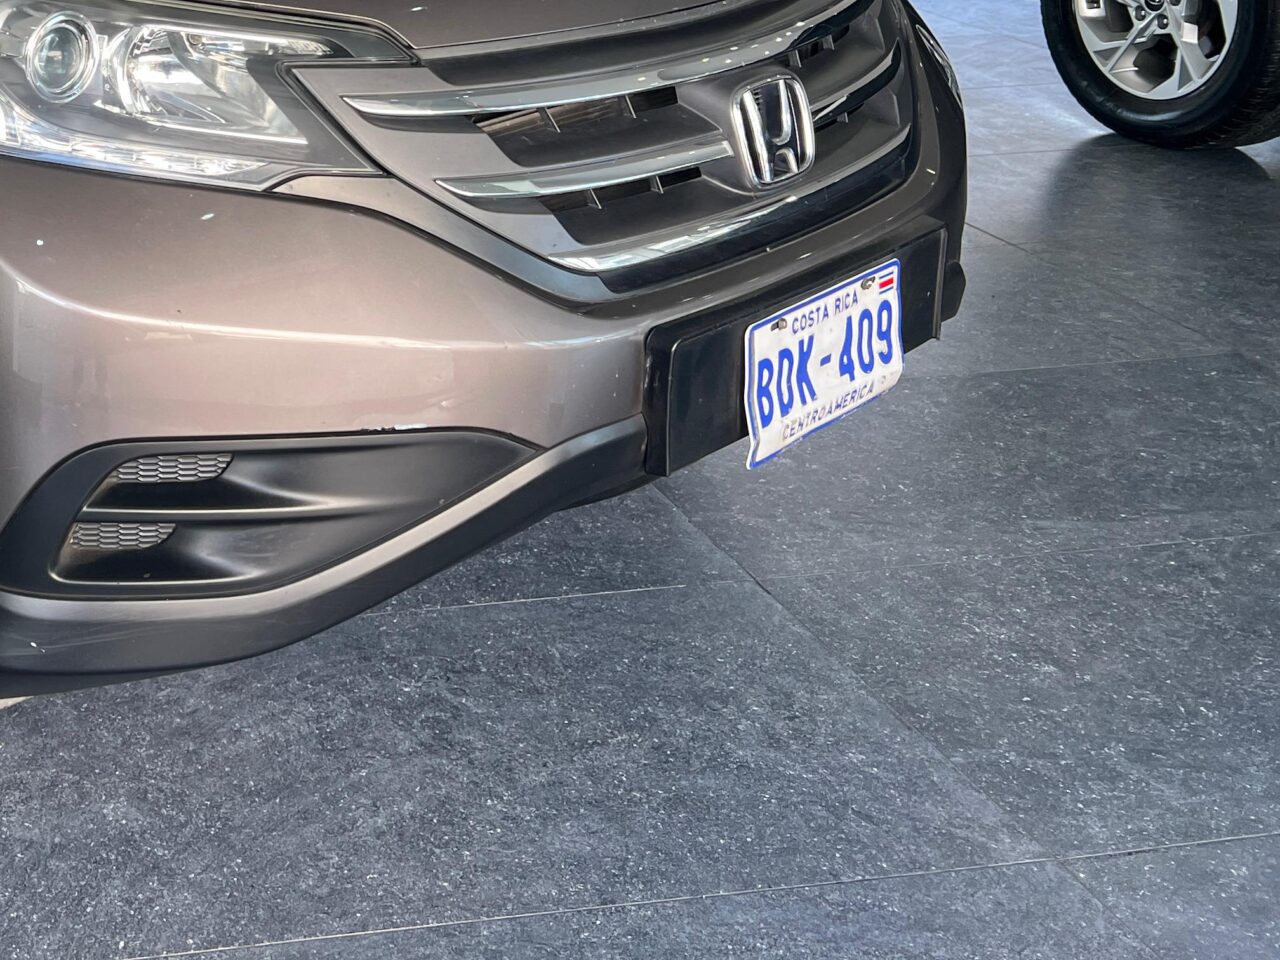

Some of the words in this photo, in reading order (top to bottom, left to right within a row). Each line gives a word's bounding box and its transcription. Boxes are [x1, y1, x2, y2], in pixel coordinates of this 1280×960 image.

[791, 304, 829, 335] COSTA
[834, 289, 859, 316] RICA
[756, 299, 893, 429] BDK-409
